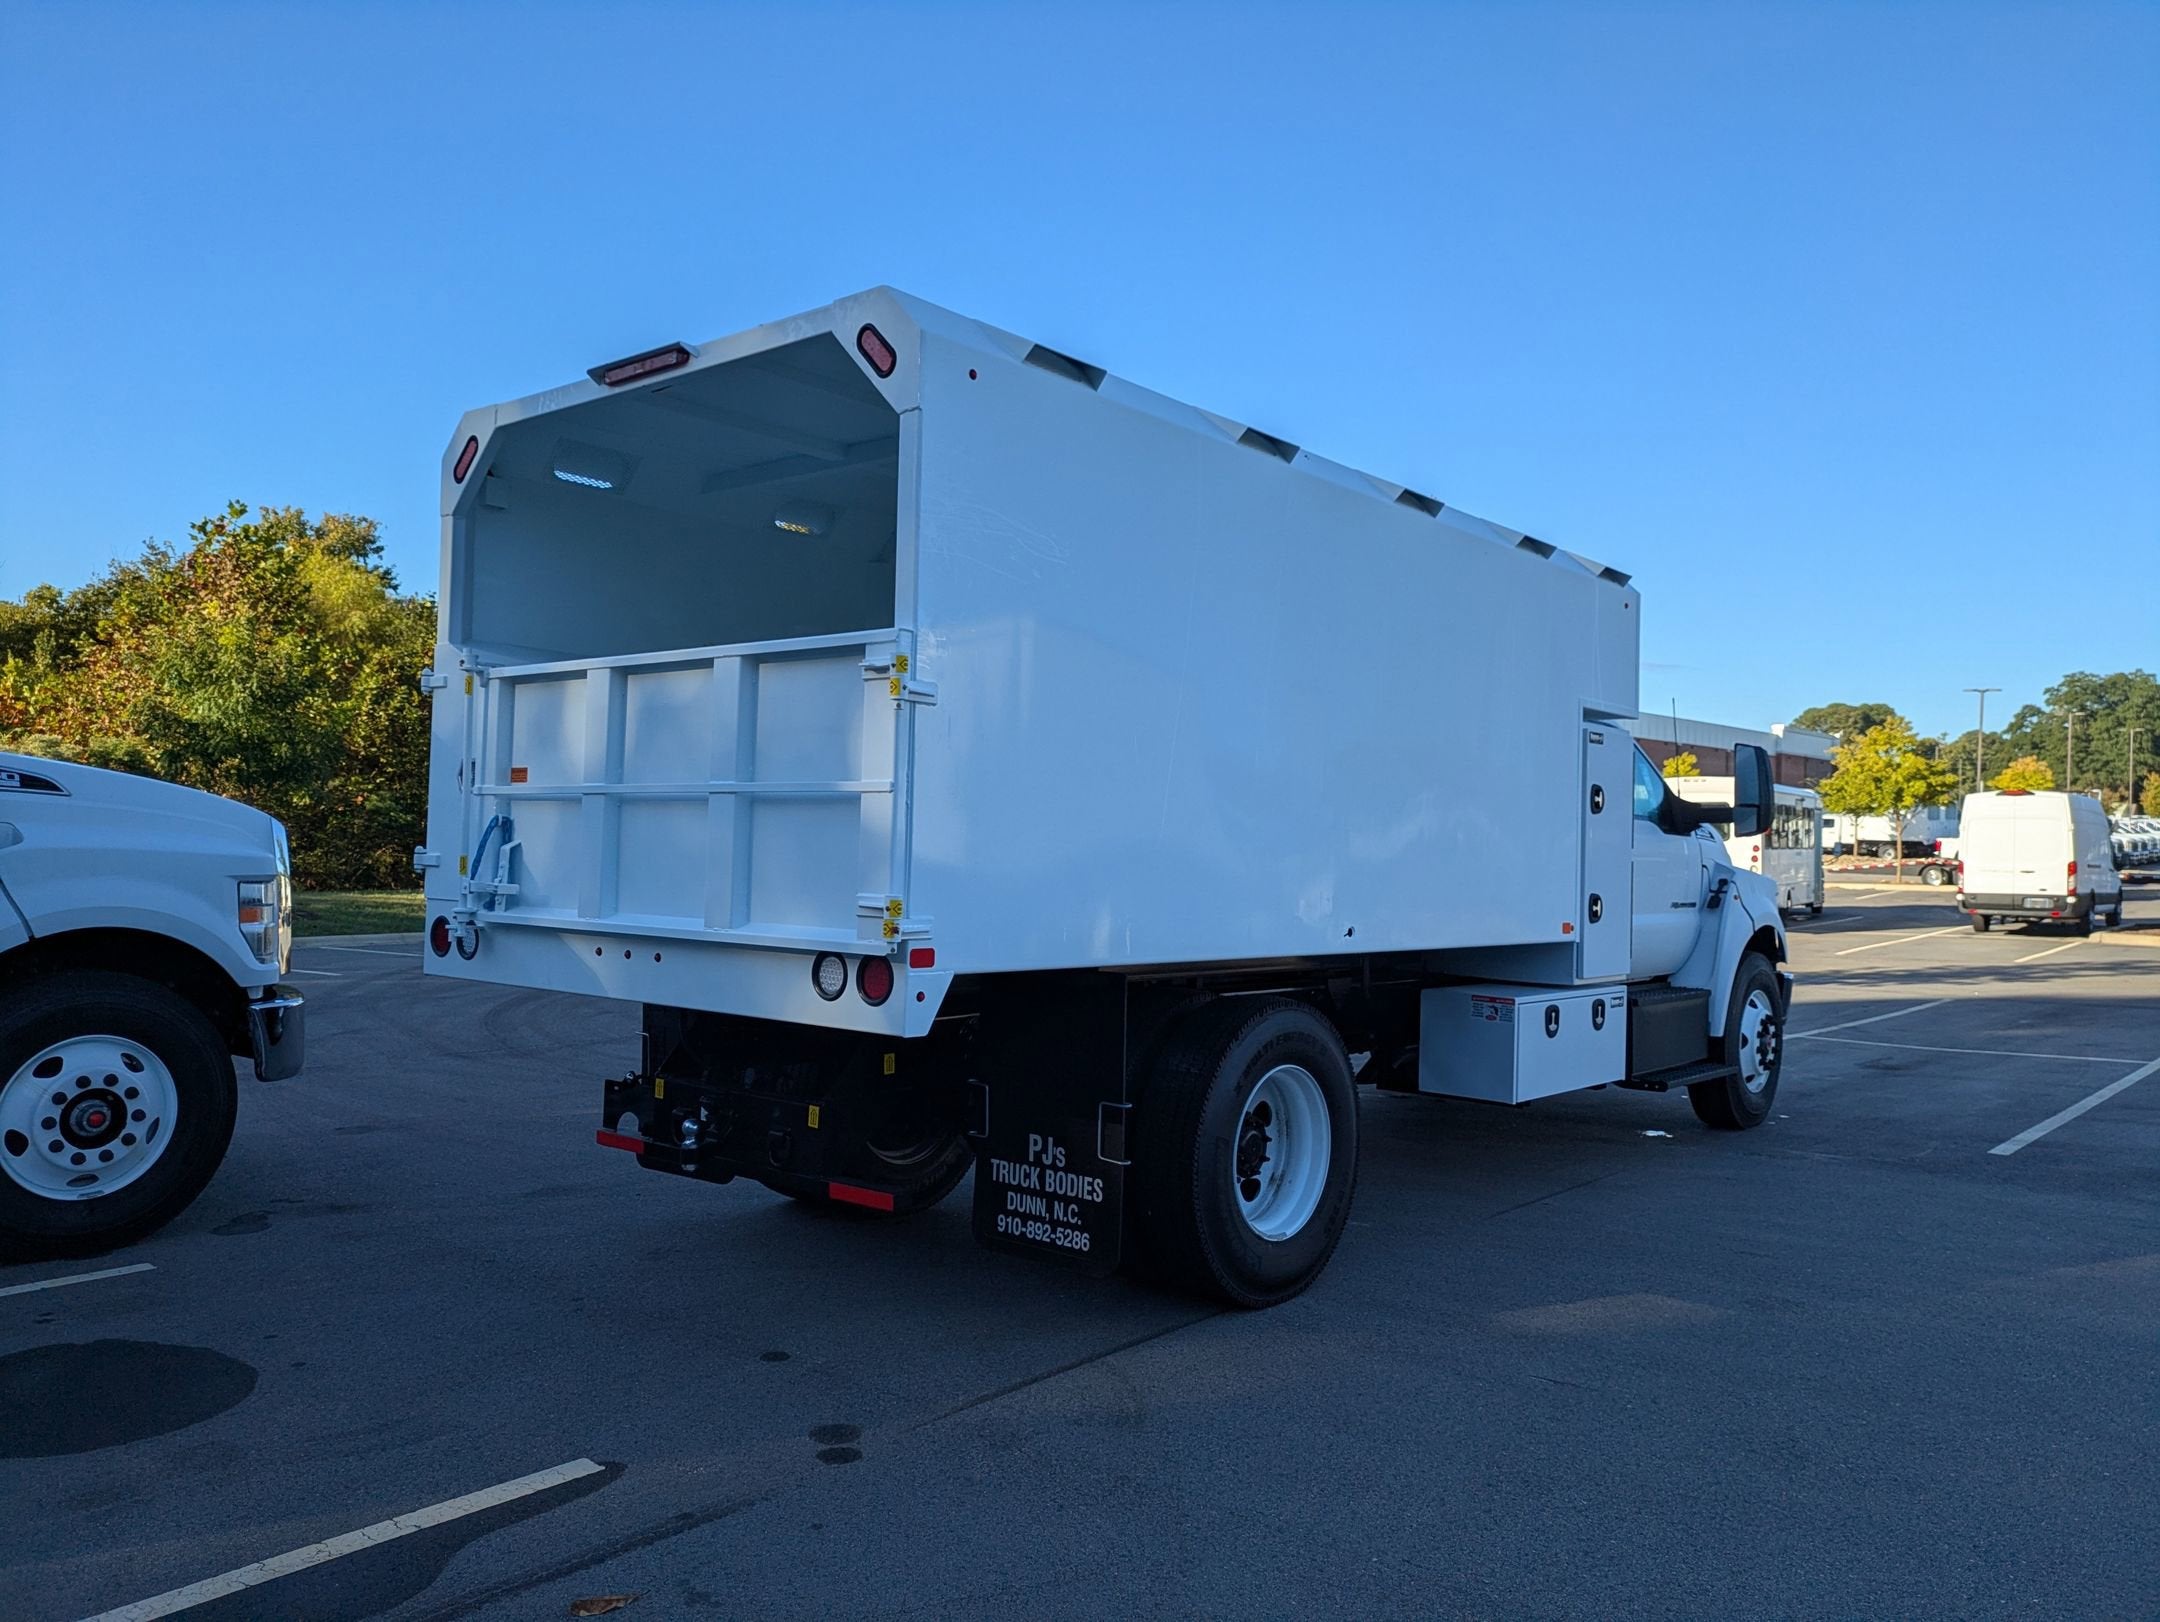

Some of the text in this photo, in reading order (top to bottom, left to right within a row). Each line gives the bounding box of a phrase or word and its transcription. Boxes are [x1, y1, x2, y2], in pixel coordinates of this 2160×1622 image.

[990, 1158, 1103, 1203] TRUCK BODIES
[1007, 1191, 1082, 1225] DUNN, N.C.
[997, 1214, 1090, 1252] 910-892-5286
